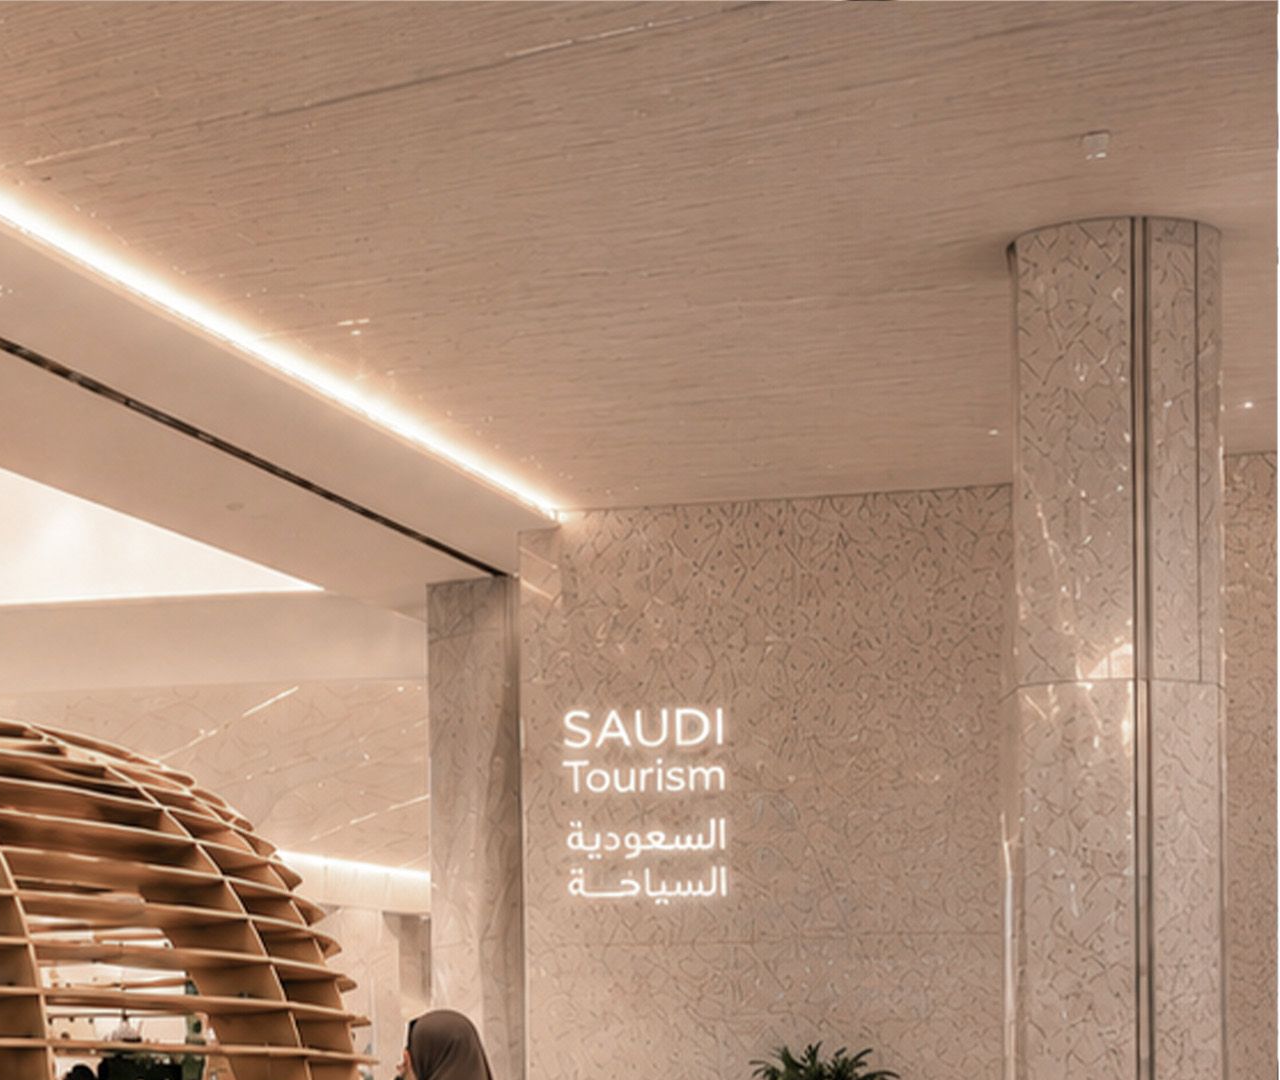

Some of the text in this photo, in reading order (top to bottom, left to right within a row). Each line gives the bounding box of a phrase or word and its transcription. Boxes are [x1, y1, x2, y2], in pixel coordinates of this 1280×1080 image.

[563, 707, 724, 749] SAUDI
[561, 757, 726, 793] Tourism
[566, 817, 726, 860] السعودية
